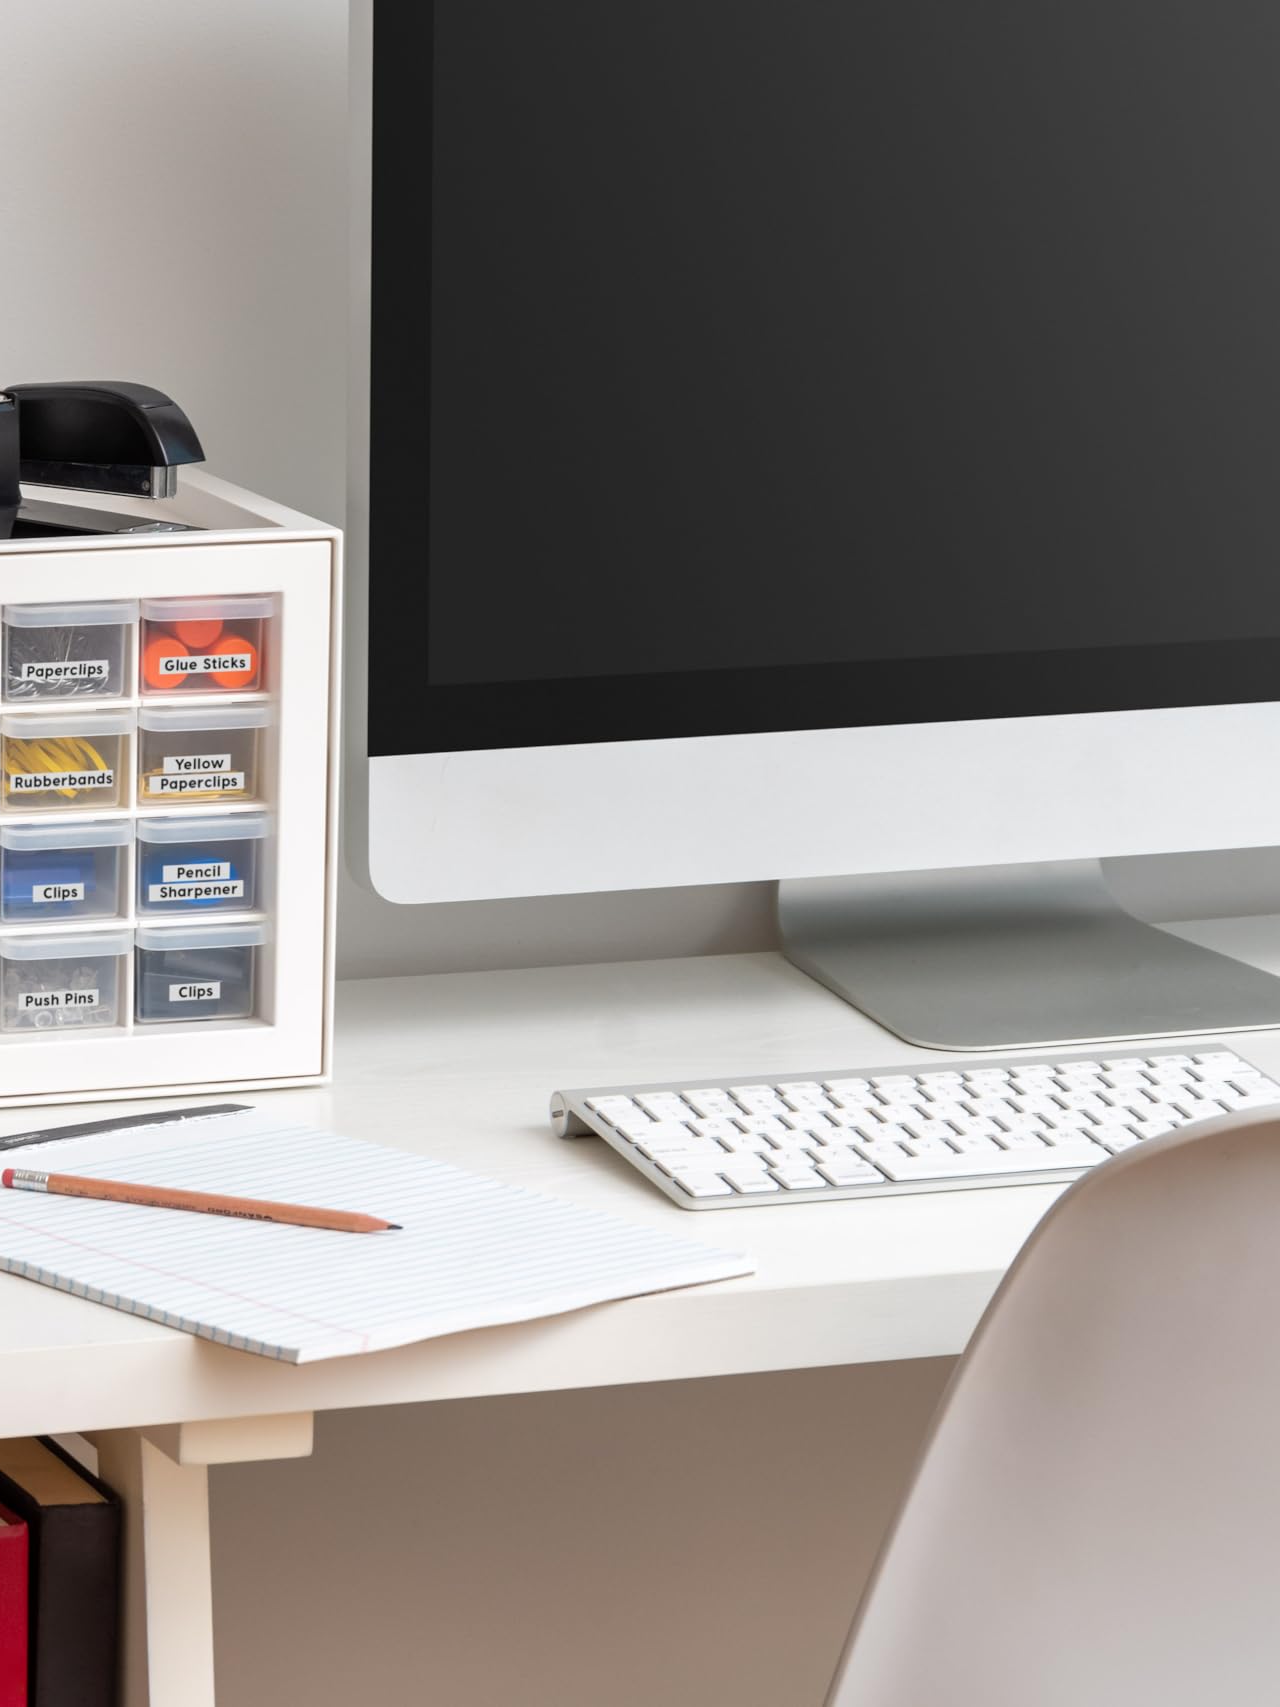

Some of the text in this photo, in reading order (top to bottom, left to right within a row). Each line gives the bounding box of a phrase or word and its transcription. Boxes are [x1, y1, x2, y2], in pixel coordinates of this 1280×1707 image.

[26, 663, 103, 680] Paperclips
[164, 657, 246, 672] Glue Sticks
[175, 757, 224, 771] Yellow
[14, 773, 113, 790] Rubberbands
[160, 775, 238, 792] Paperclips
[177, 865, 221, 879] Pencil
[43, 886, 78, 901] Clips
[160, 883, 238, 899] Sharpener
[25, 992, 94, 1007] Push Pins
[178, 985, 214, 1000] Clips
